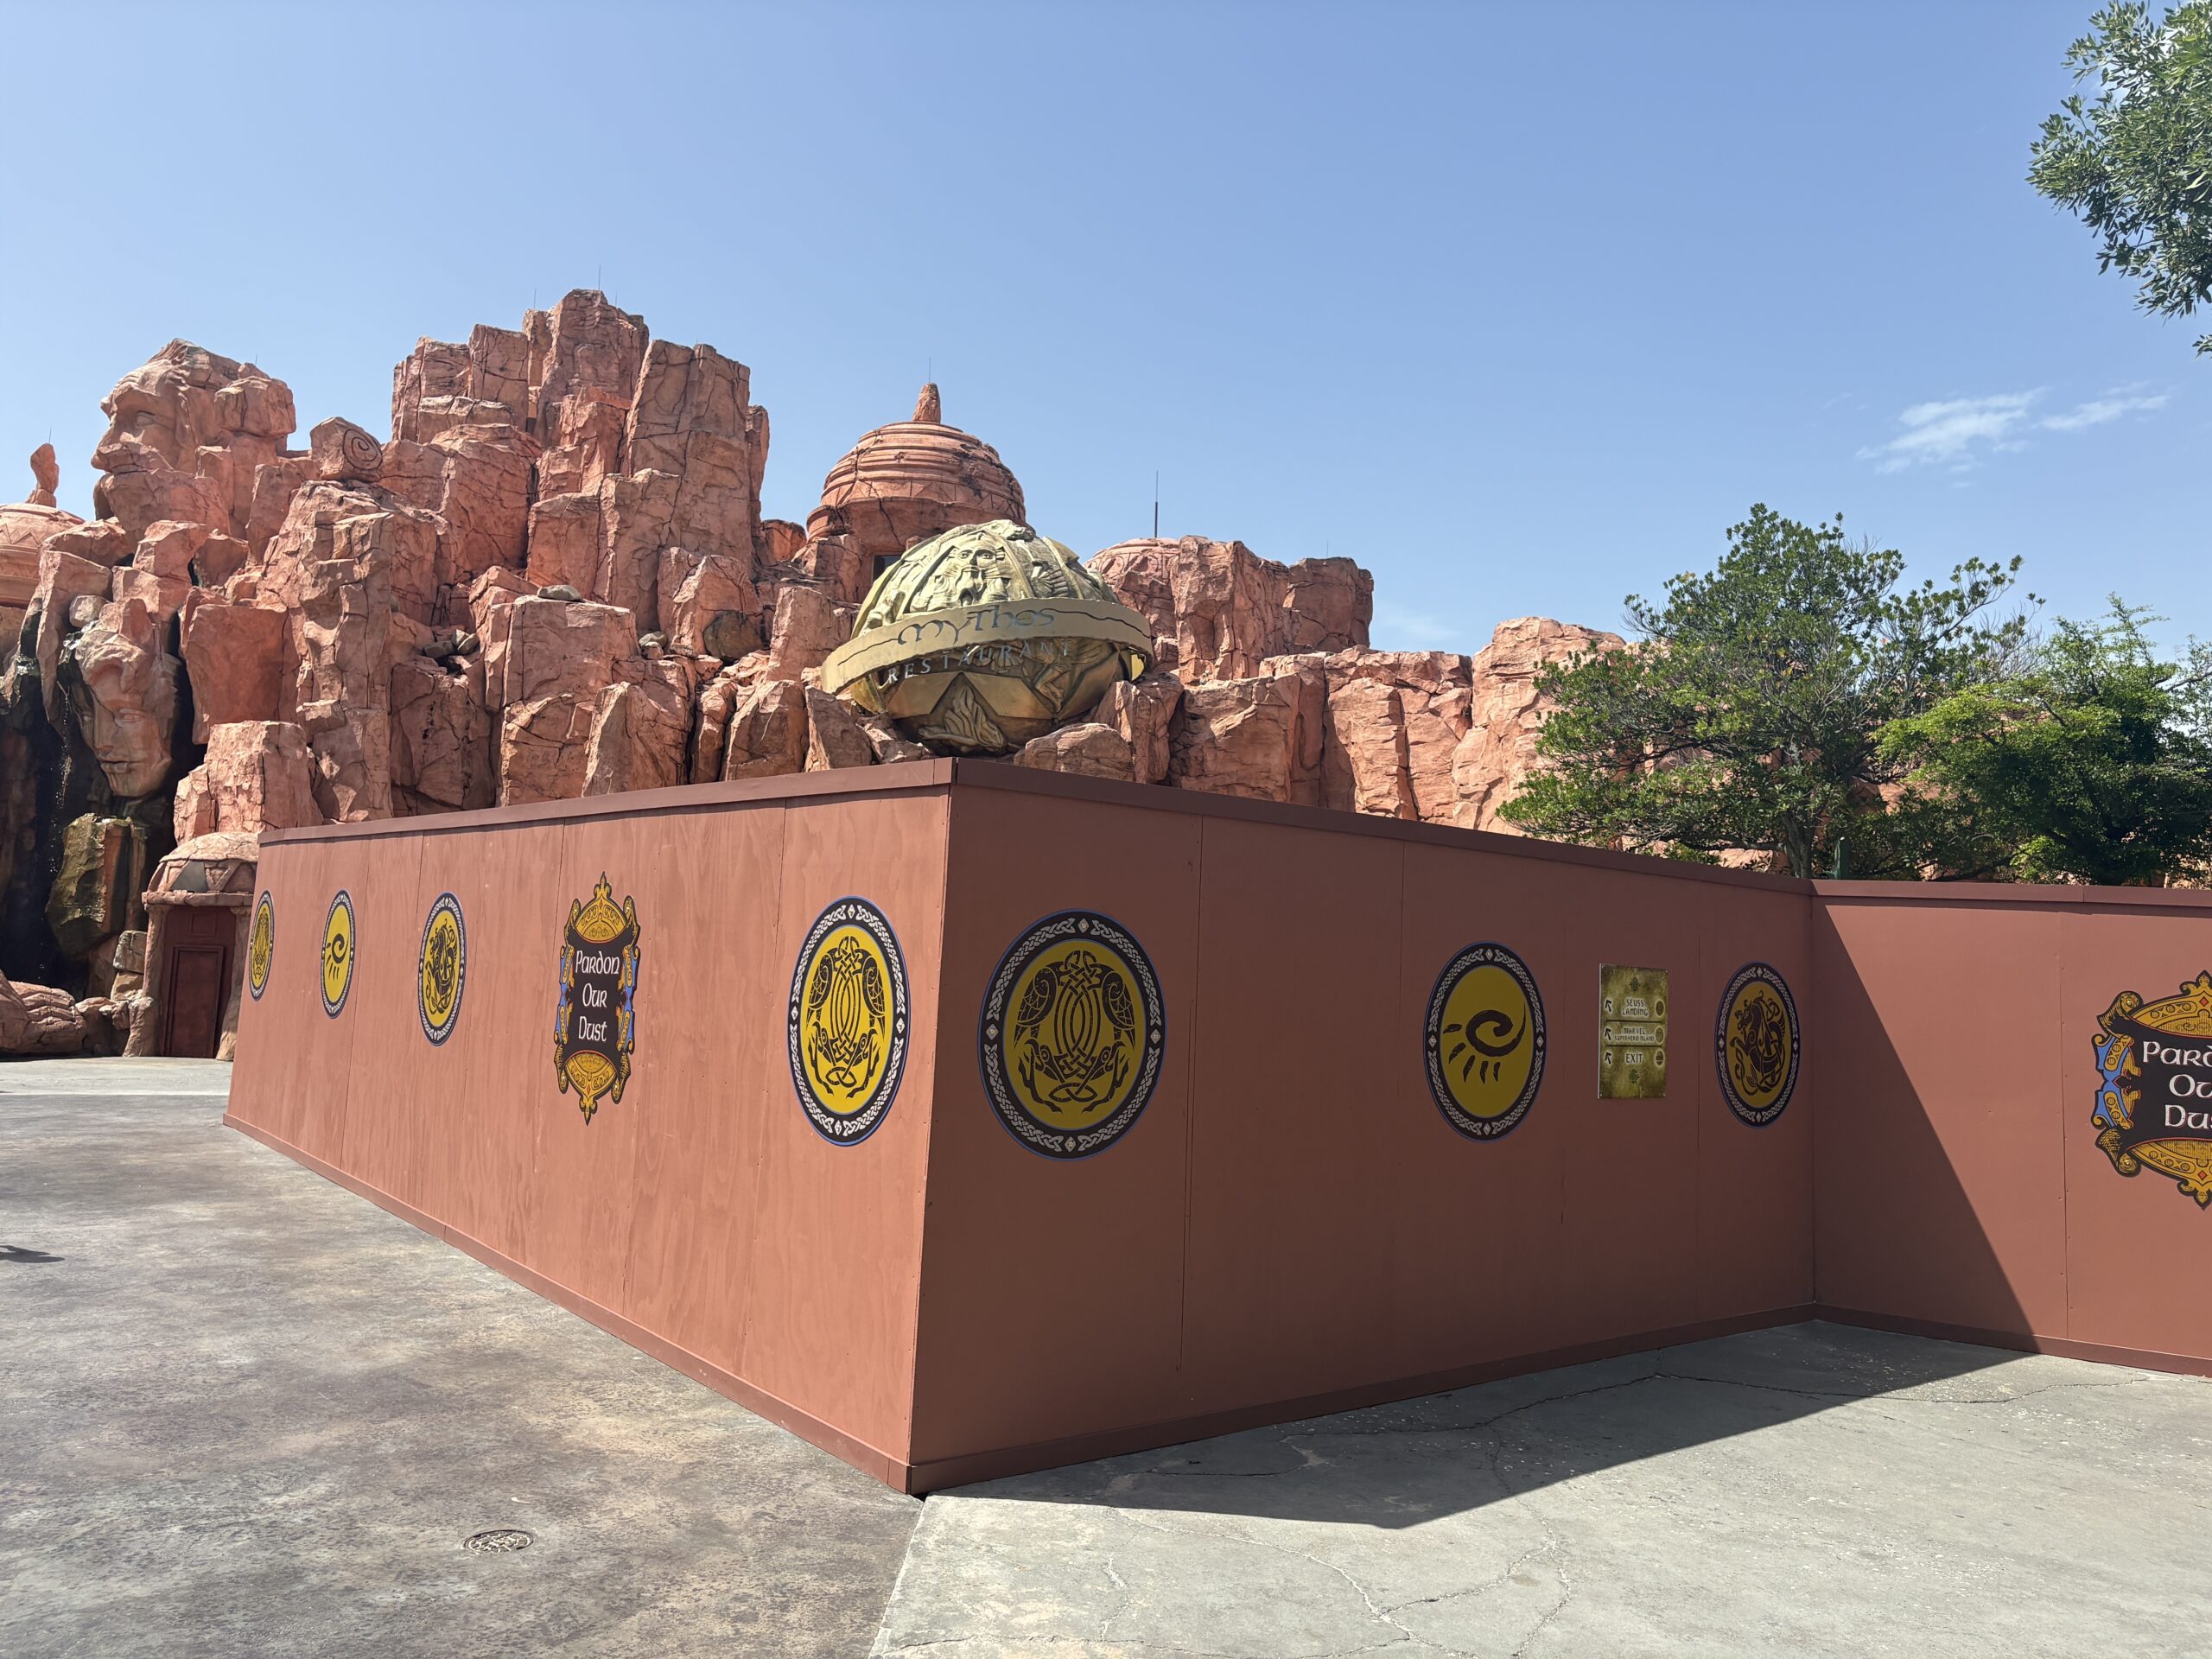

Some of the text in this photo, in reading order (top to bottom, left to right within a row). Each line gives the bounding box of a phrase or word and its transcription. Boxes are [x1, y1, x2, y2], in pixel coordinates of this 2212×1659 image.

[887, 640, 1070, 683] RESTAURANT
[575, 950, 620, 975] Pardon
[582, 982, 607, 1008] Our
[1625, 998, 1645, 1007] SEUSS
[578, 1015, 607, 1042] Dust
[1625, 1052, 1643, 1064] EXIT
[2164, 1104, 2212, 1129] Du
